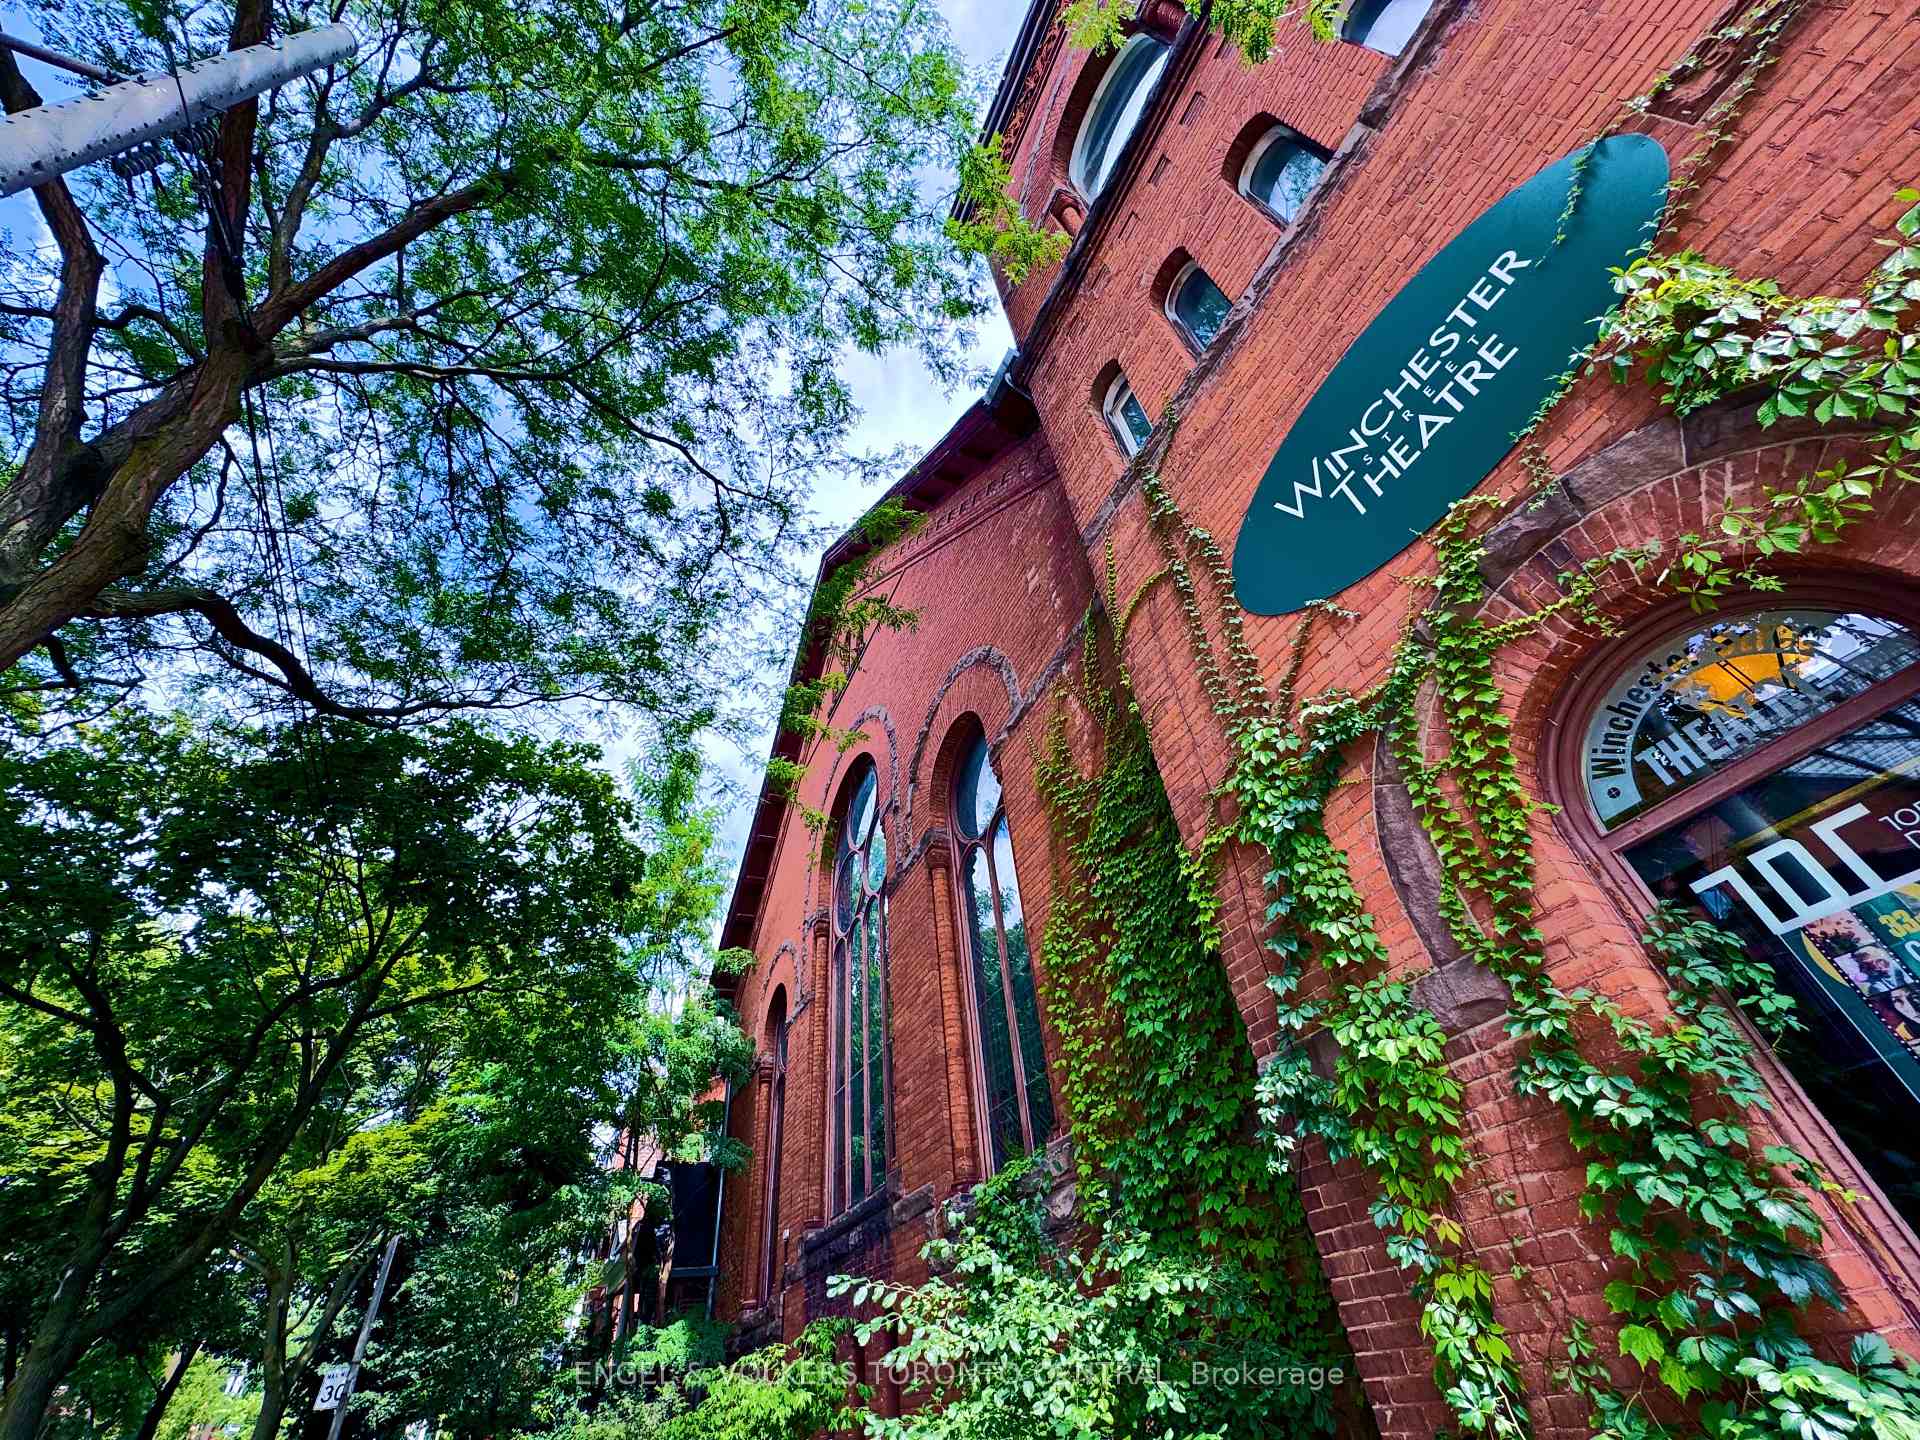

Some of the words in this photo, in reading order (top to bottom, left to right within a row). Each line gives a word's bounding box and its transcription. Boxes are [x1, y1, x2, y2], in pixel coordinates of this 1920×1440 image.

[1274, 250, 1532, 519] WINCHESTER
[1329, 333, 1519, 515] THEATRE
[1363, 333, 1480, 466] STREET
[321, 1383, 345, 1403] 30
